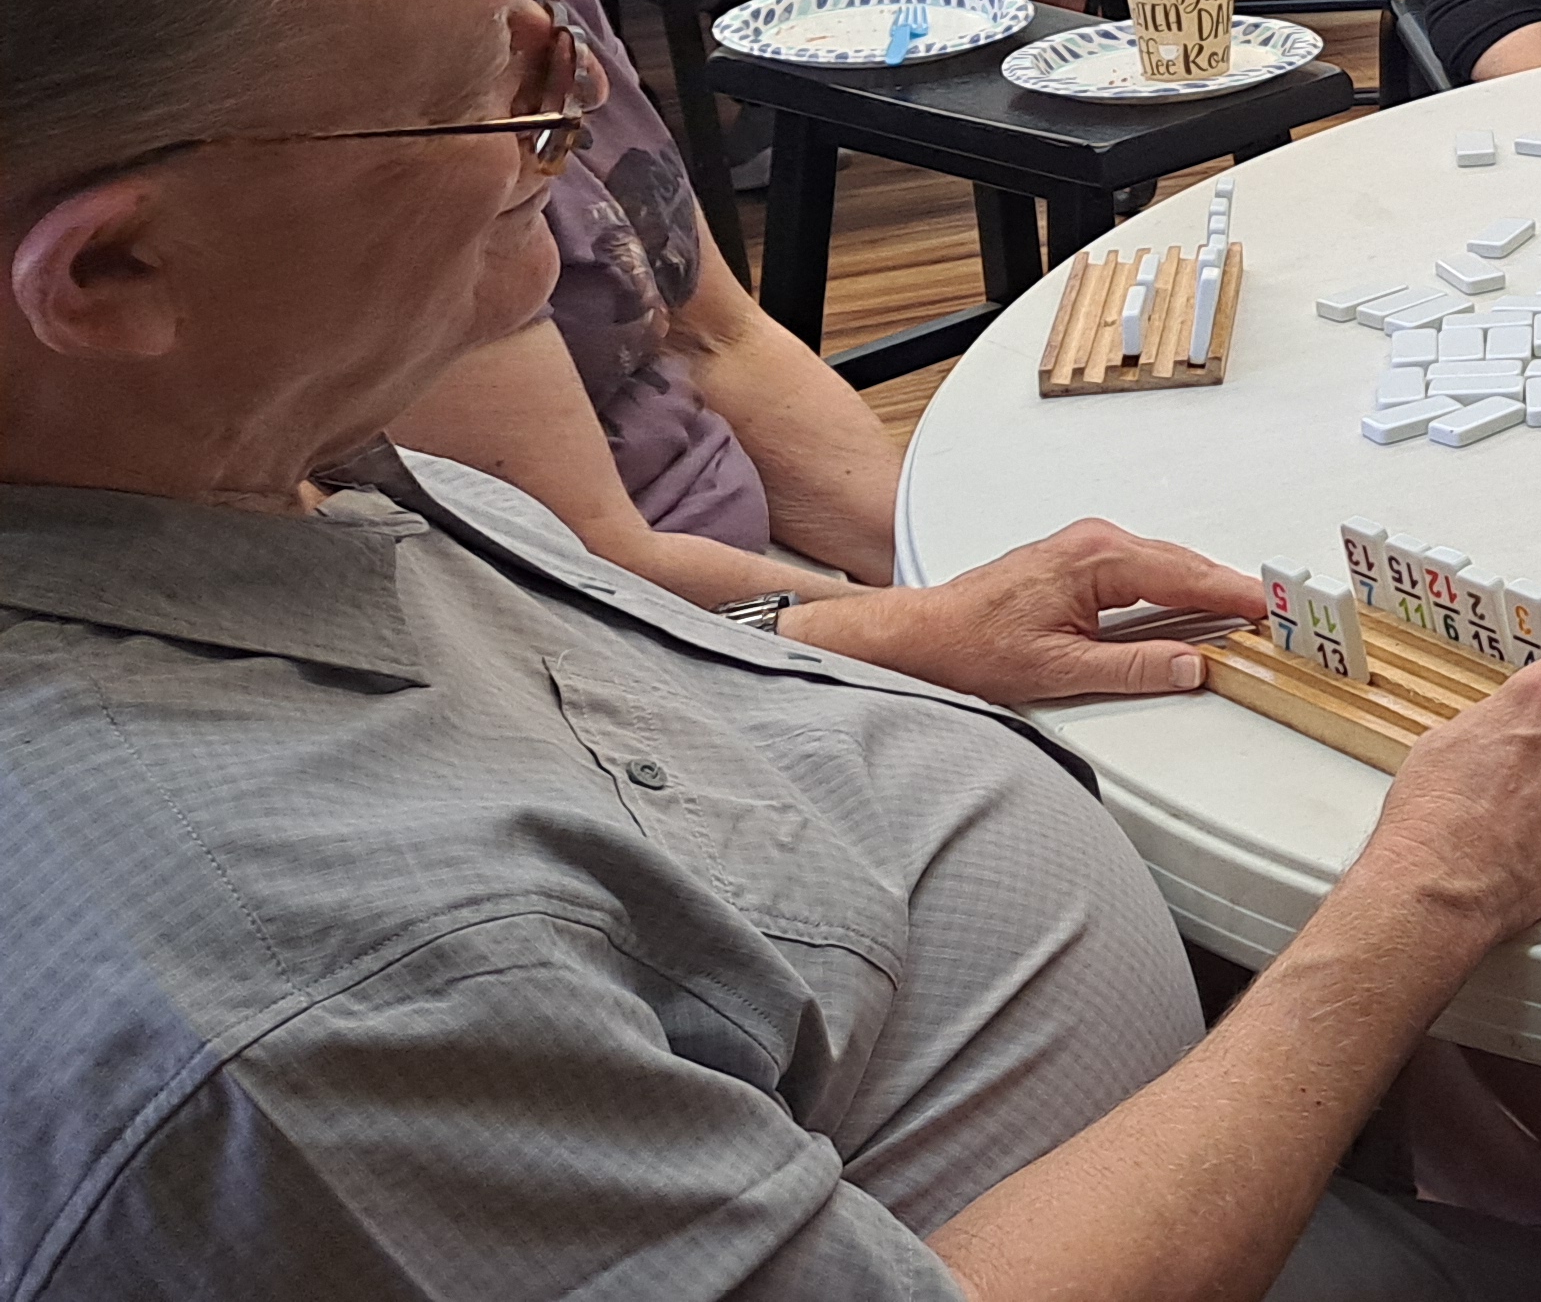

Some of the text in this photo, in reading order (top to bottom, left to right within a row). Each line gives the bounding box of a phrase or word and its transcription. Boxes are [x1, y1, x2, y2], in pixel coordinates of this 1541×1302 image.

[1344, 538, 1375, 572] 13
[1388, 555, 1419, 590] 15
[1424, 568, 1458, 604] 12
[1272, 582, 1288, 613] 5
[1359, 579, 1374, 606] 7
[1466, 591, 1486, 621] 2
[1308, 599, 1337, 634] 11
[1398, 597, 1427, 629] 11
[1515, 605, 1532, 636] 3
[1278, 621, 1293, 651] 7
[1472, 630, 1505, 662] 15
[1316, 642, 1349, 677] 13
